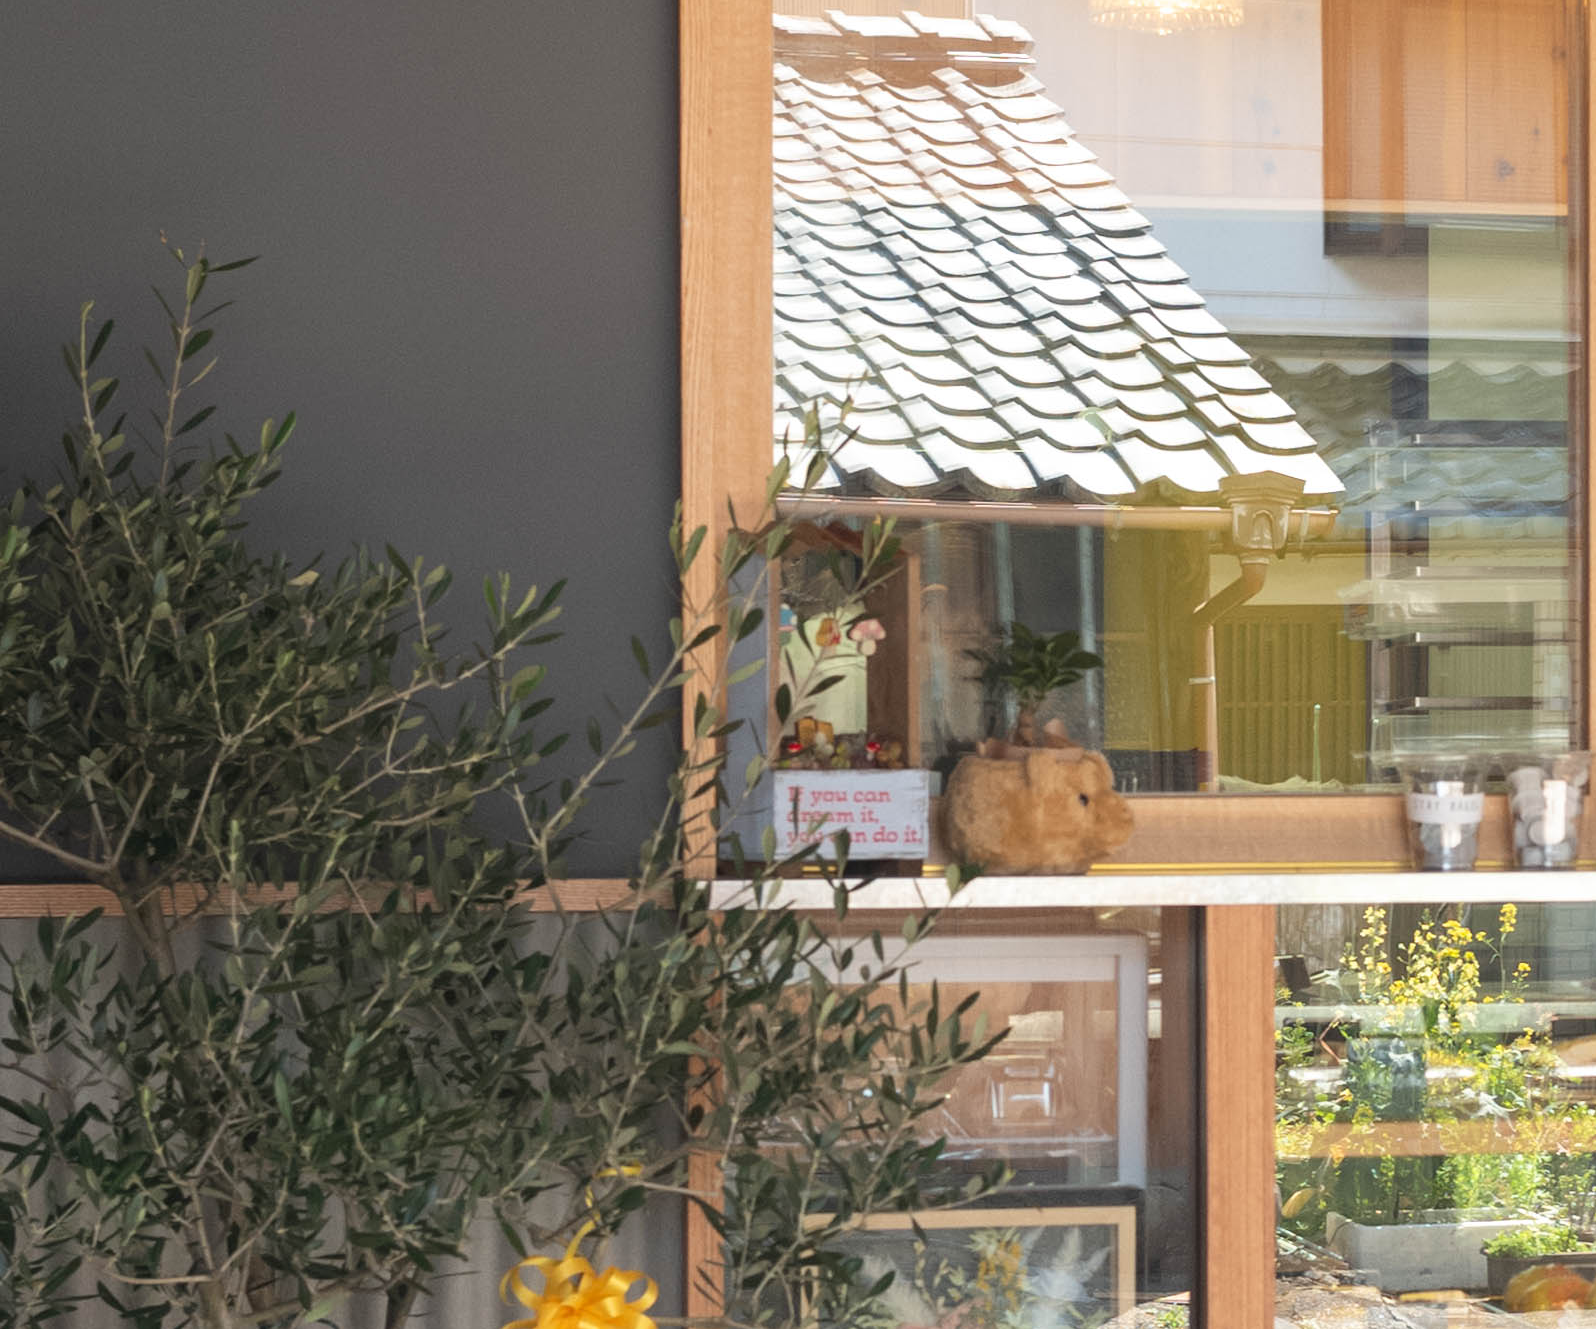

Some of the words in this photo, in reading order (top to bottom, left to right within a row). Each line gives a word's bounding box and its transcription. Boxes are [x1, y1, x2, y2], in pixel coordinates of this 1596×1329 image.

[810, 789, 848, 806] you
[853, 790, 891, 803] can
[872, 826, 898, 843] do
